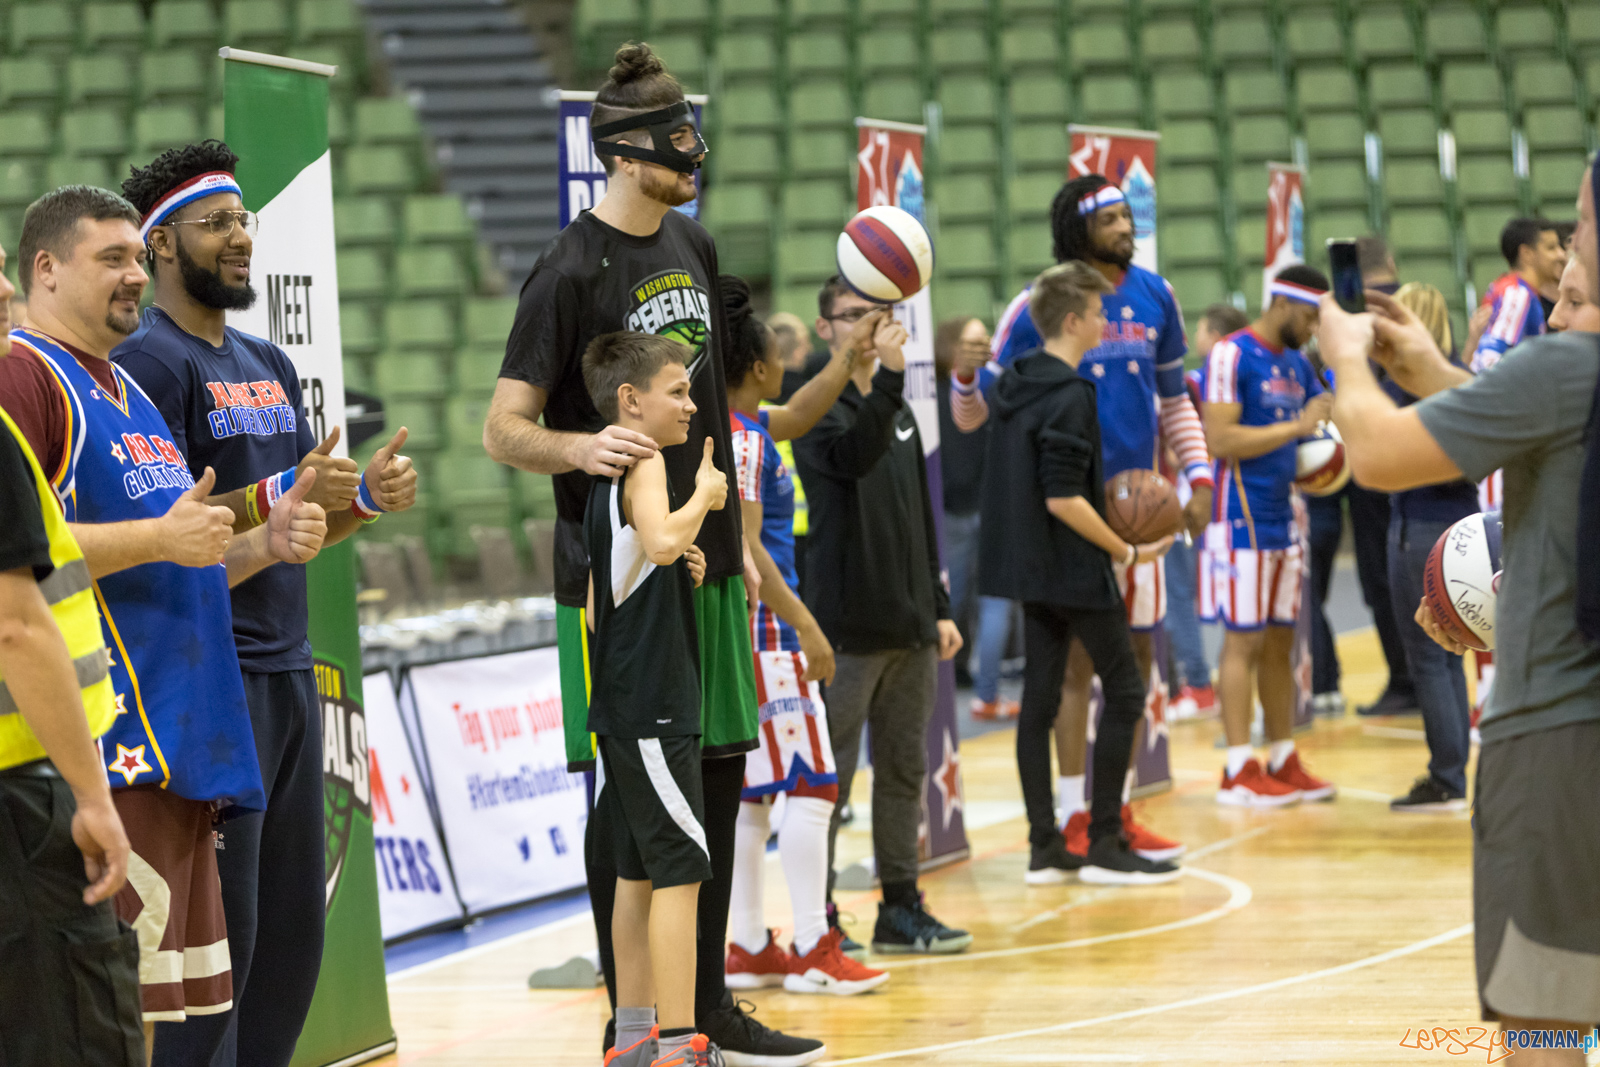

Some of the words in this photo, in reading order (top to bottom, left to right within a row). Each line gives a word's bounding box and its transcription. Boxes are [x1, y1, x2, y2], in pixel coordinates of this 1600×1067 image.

[267, 274, 313, 345] MEET
[628, 288, 712, 335] GENERALS
[635, 273, 694, 303] WASHINGTON
[206, 380, 290, 409] HARLEM
[452, 702, 488, 754] Tag
[486, 705, 521, 752] your
